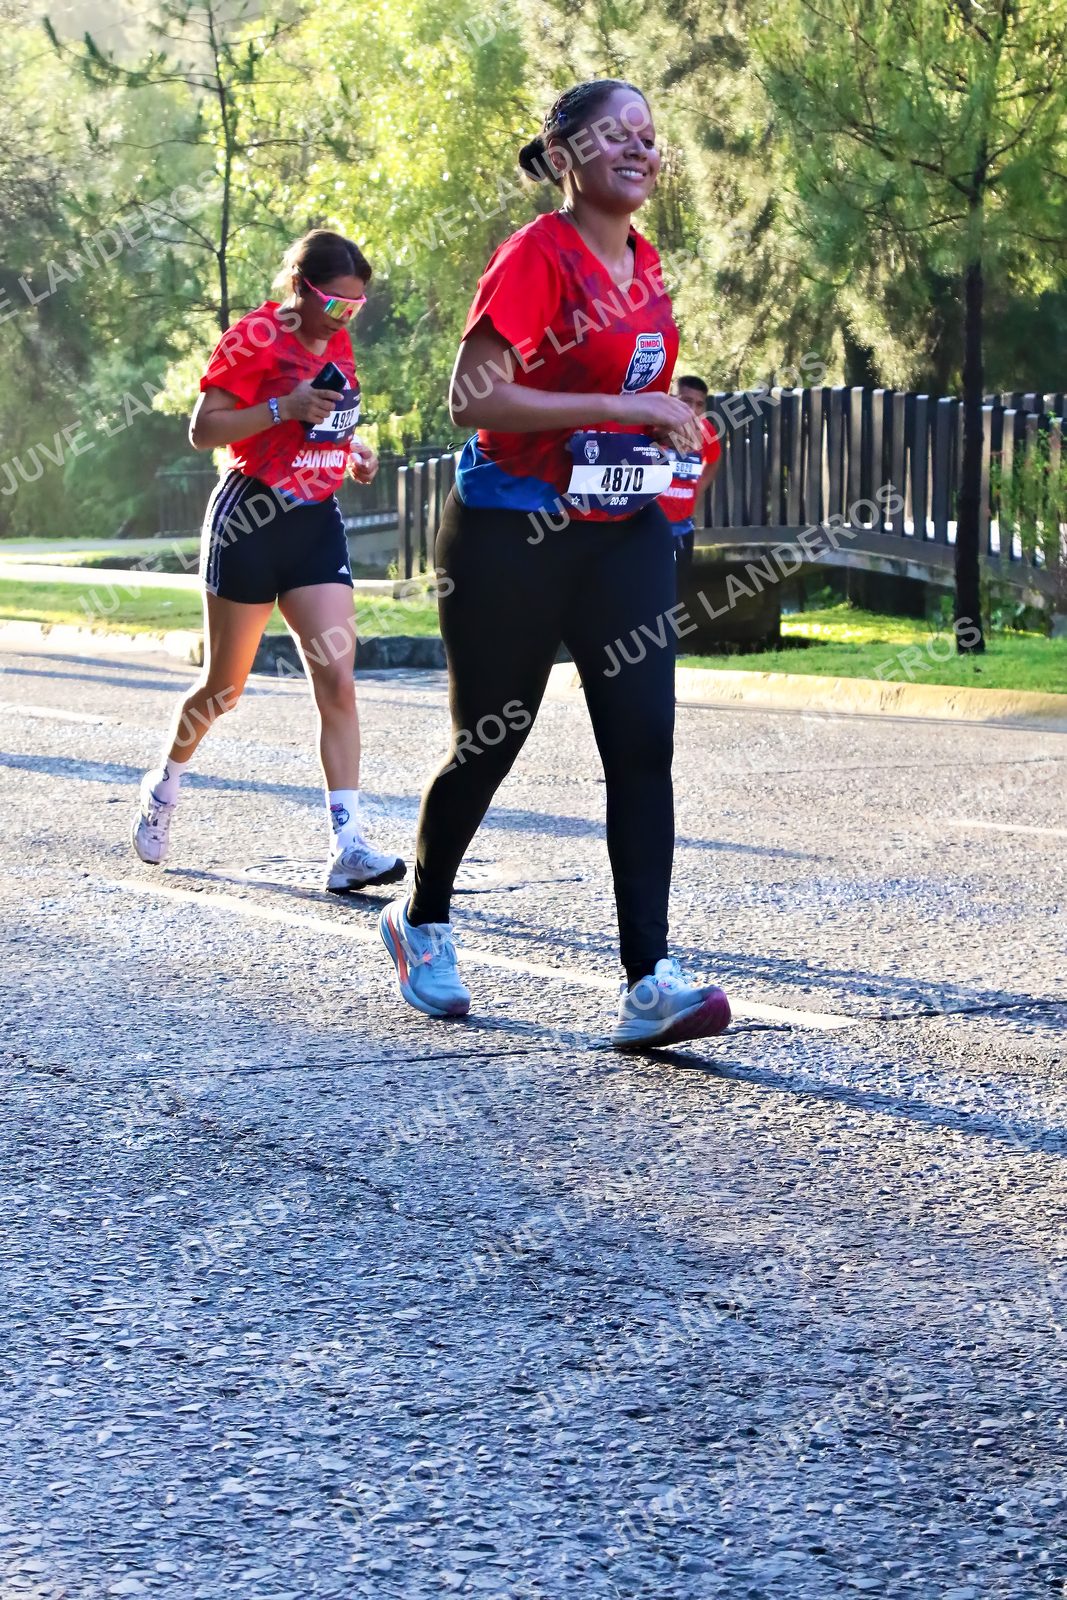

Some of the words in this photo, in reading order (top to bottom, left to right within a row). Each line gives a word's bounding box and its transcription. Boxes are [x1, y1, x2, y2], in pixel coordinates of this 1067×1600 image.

[640, 340, 660, 349] BIMBO
[639, 352, 658, 364] Global
[291, 449, 345, 468] SANTIO
[601, 466, 644, 492] 4870
